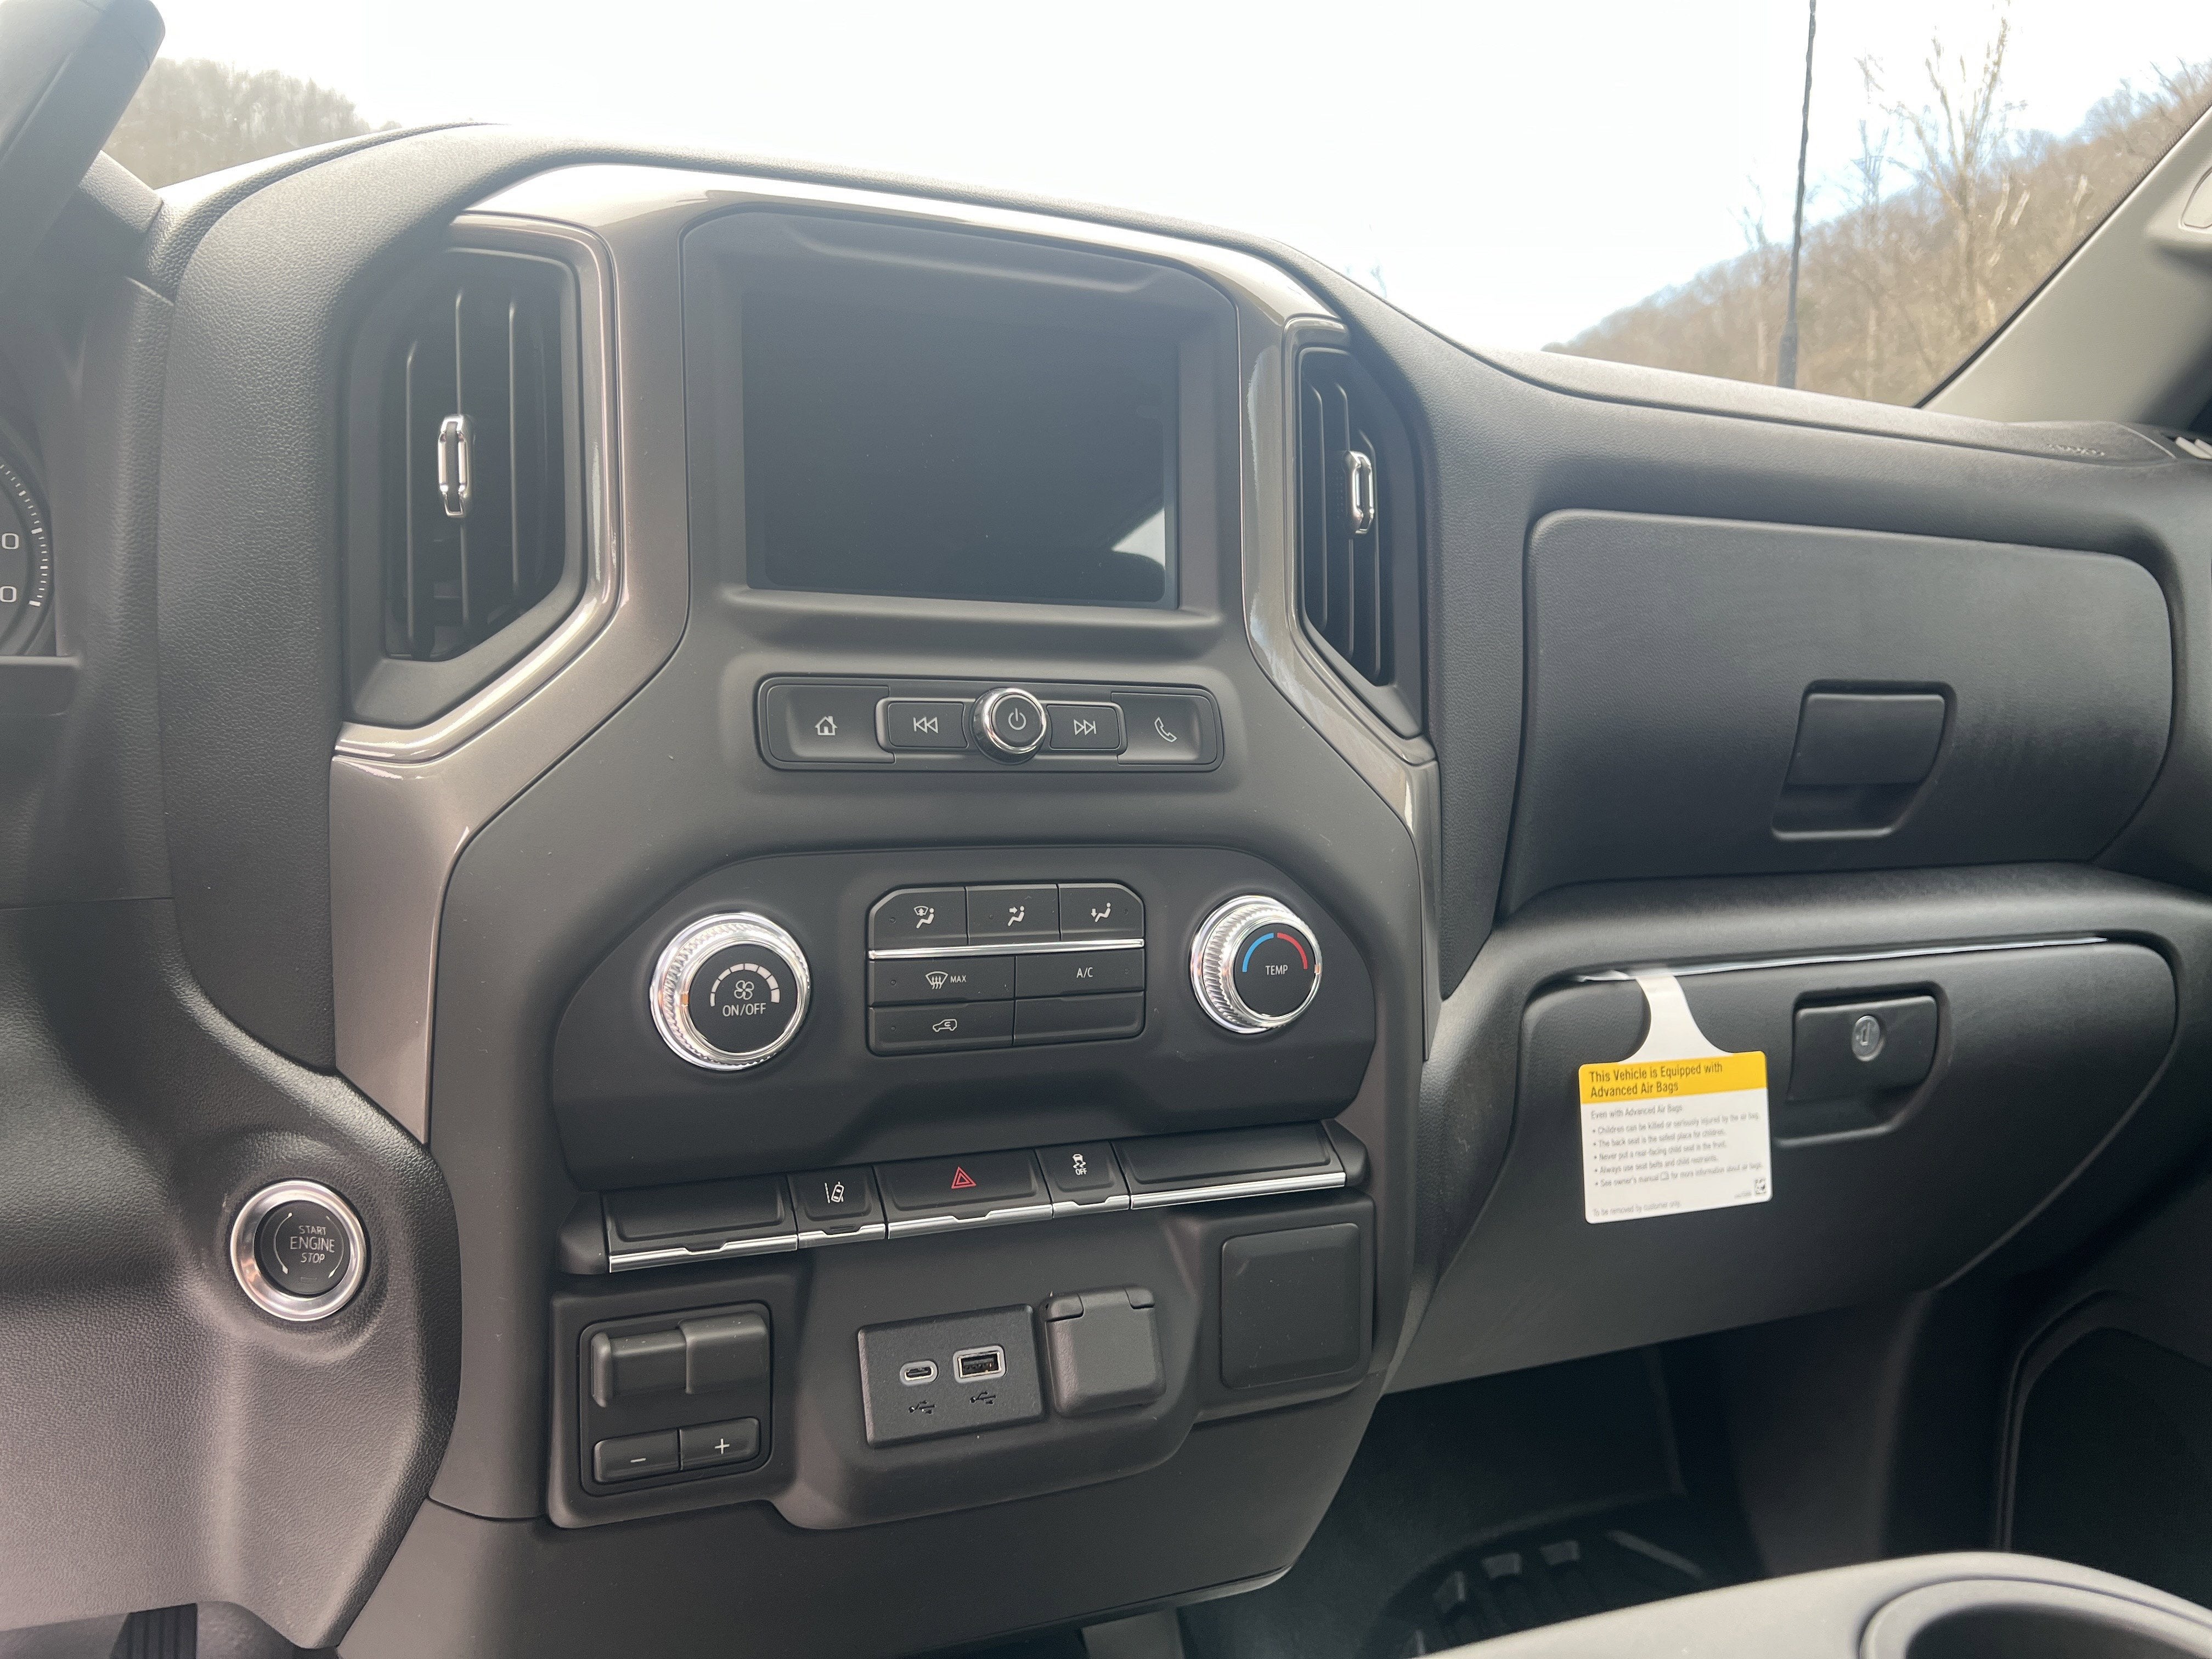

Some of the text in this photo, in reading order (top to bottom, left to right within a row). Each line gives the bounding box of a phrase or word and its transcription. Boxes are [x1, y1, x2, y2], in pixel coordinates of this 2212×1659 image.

[2, 533, 19, 550] 0
[0, 586, 17, 602] 0
[1076, 967, 1093, 978] A/C
[1266, 964, 1288, 975] TEMP
[950, 975, 967, 983] MAX
[723, 1003, 766, 1017] ON/OFF
[1589, 1062, 1723, 1082] This Vehicle is Equipped with
[1591, 1081, 1679, 1098] Advanced Air Bags
[298, 1225, 326, 1235] START
[290, 1236, 335, 1253] ENGINE
[301, 1252, 325, 1263] STOP
